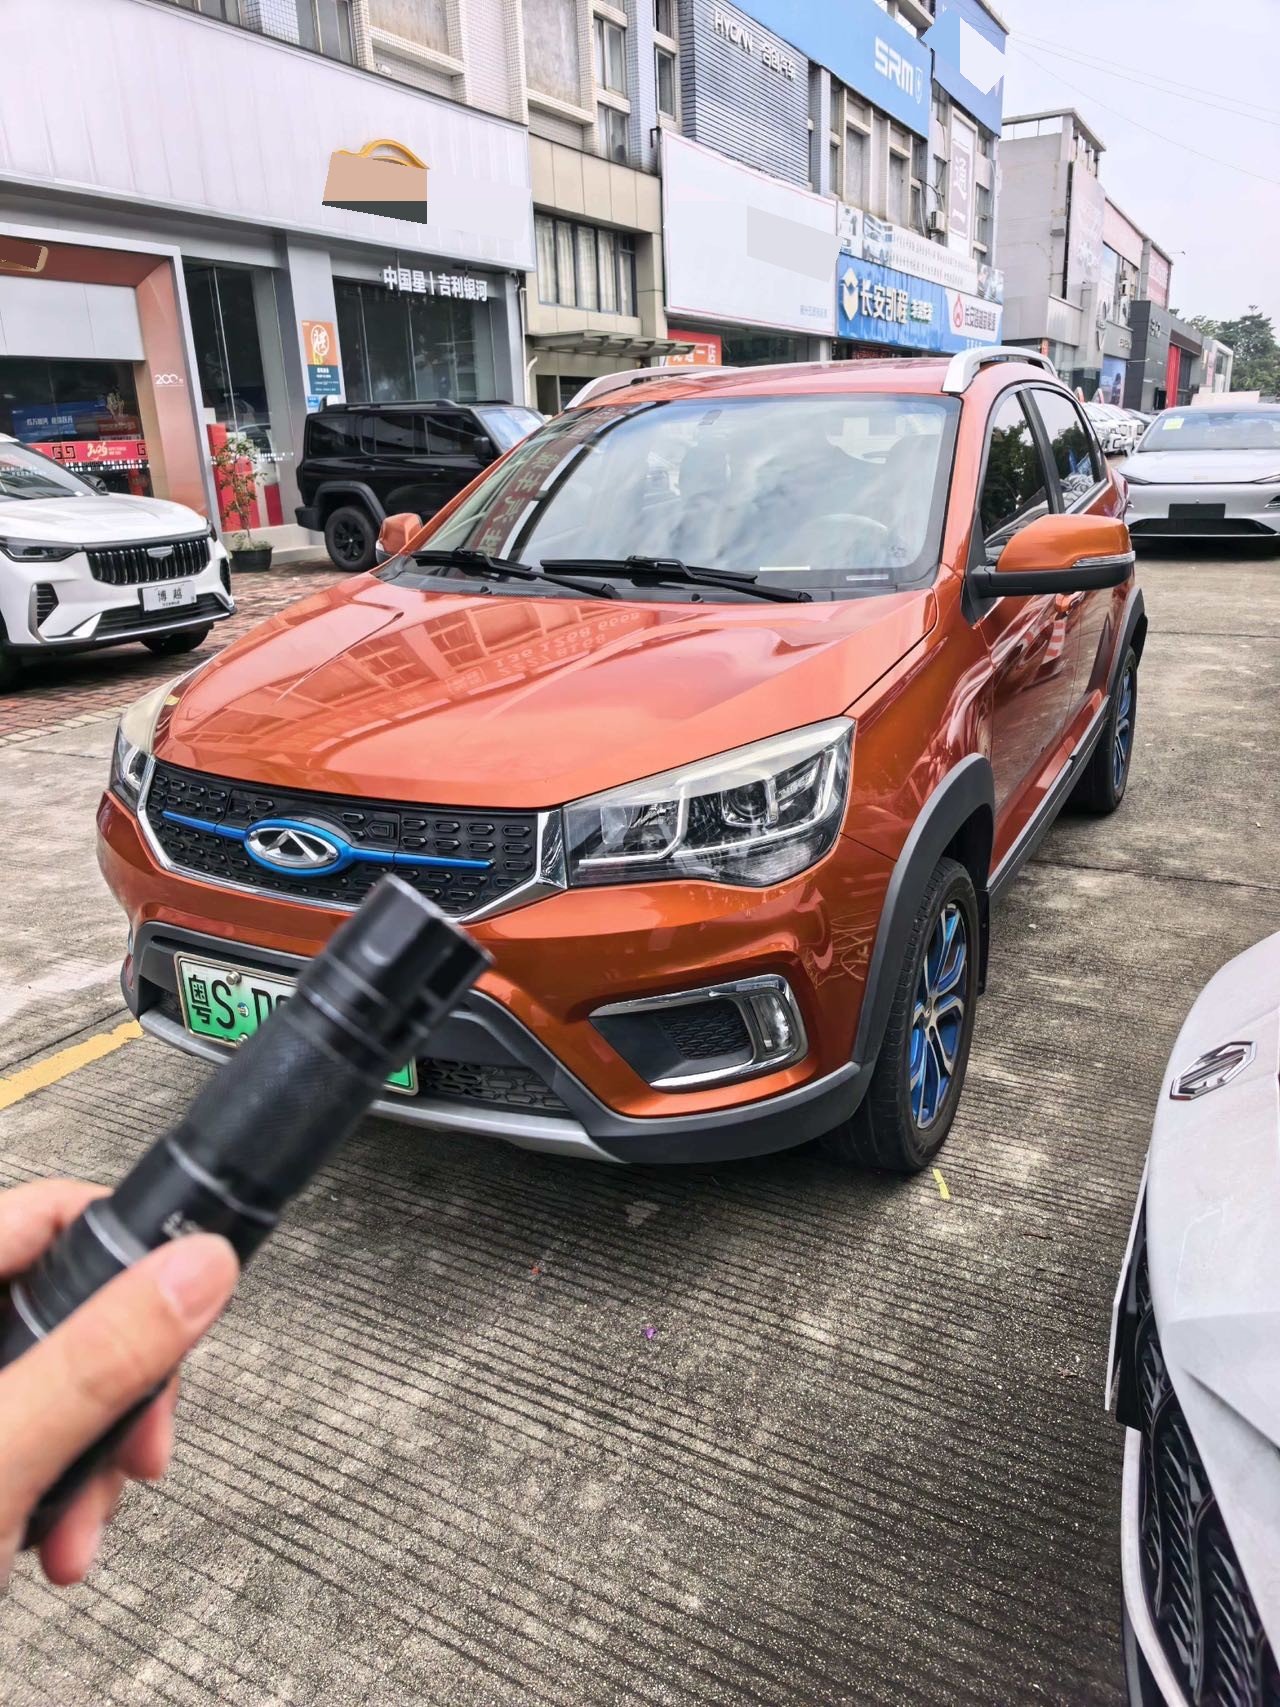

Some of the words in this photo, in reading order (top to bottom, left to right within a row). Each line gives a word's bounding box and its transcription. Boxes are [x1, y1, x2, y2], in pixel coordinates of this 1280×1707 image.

[874, 35, 914, 97] SRM
[859, 279, 909, 325] 长安凯程
[188, 974, 292, 1030] 粤SD
